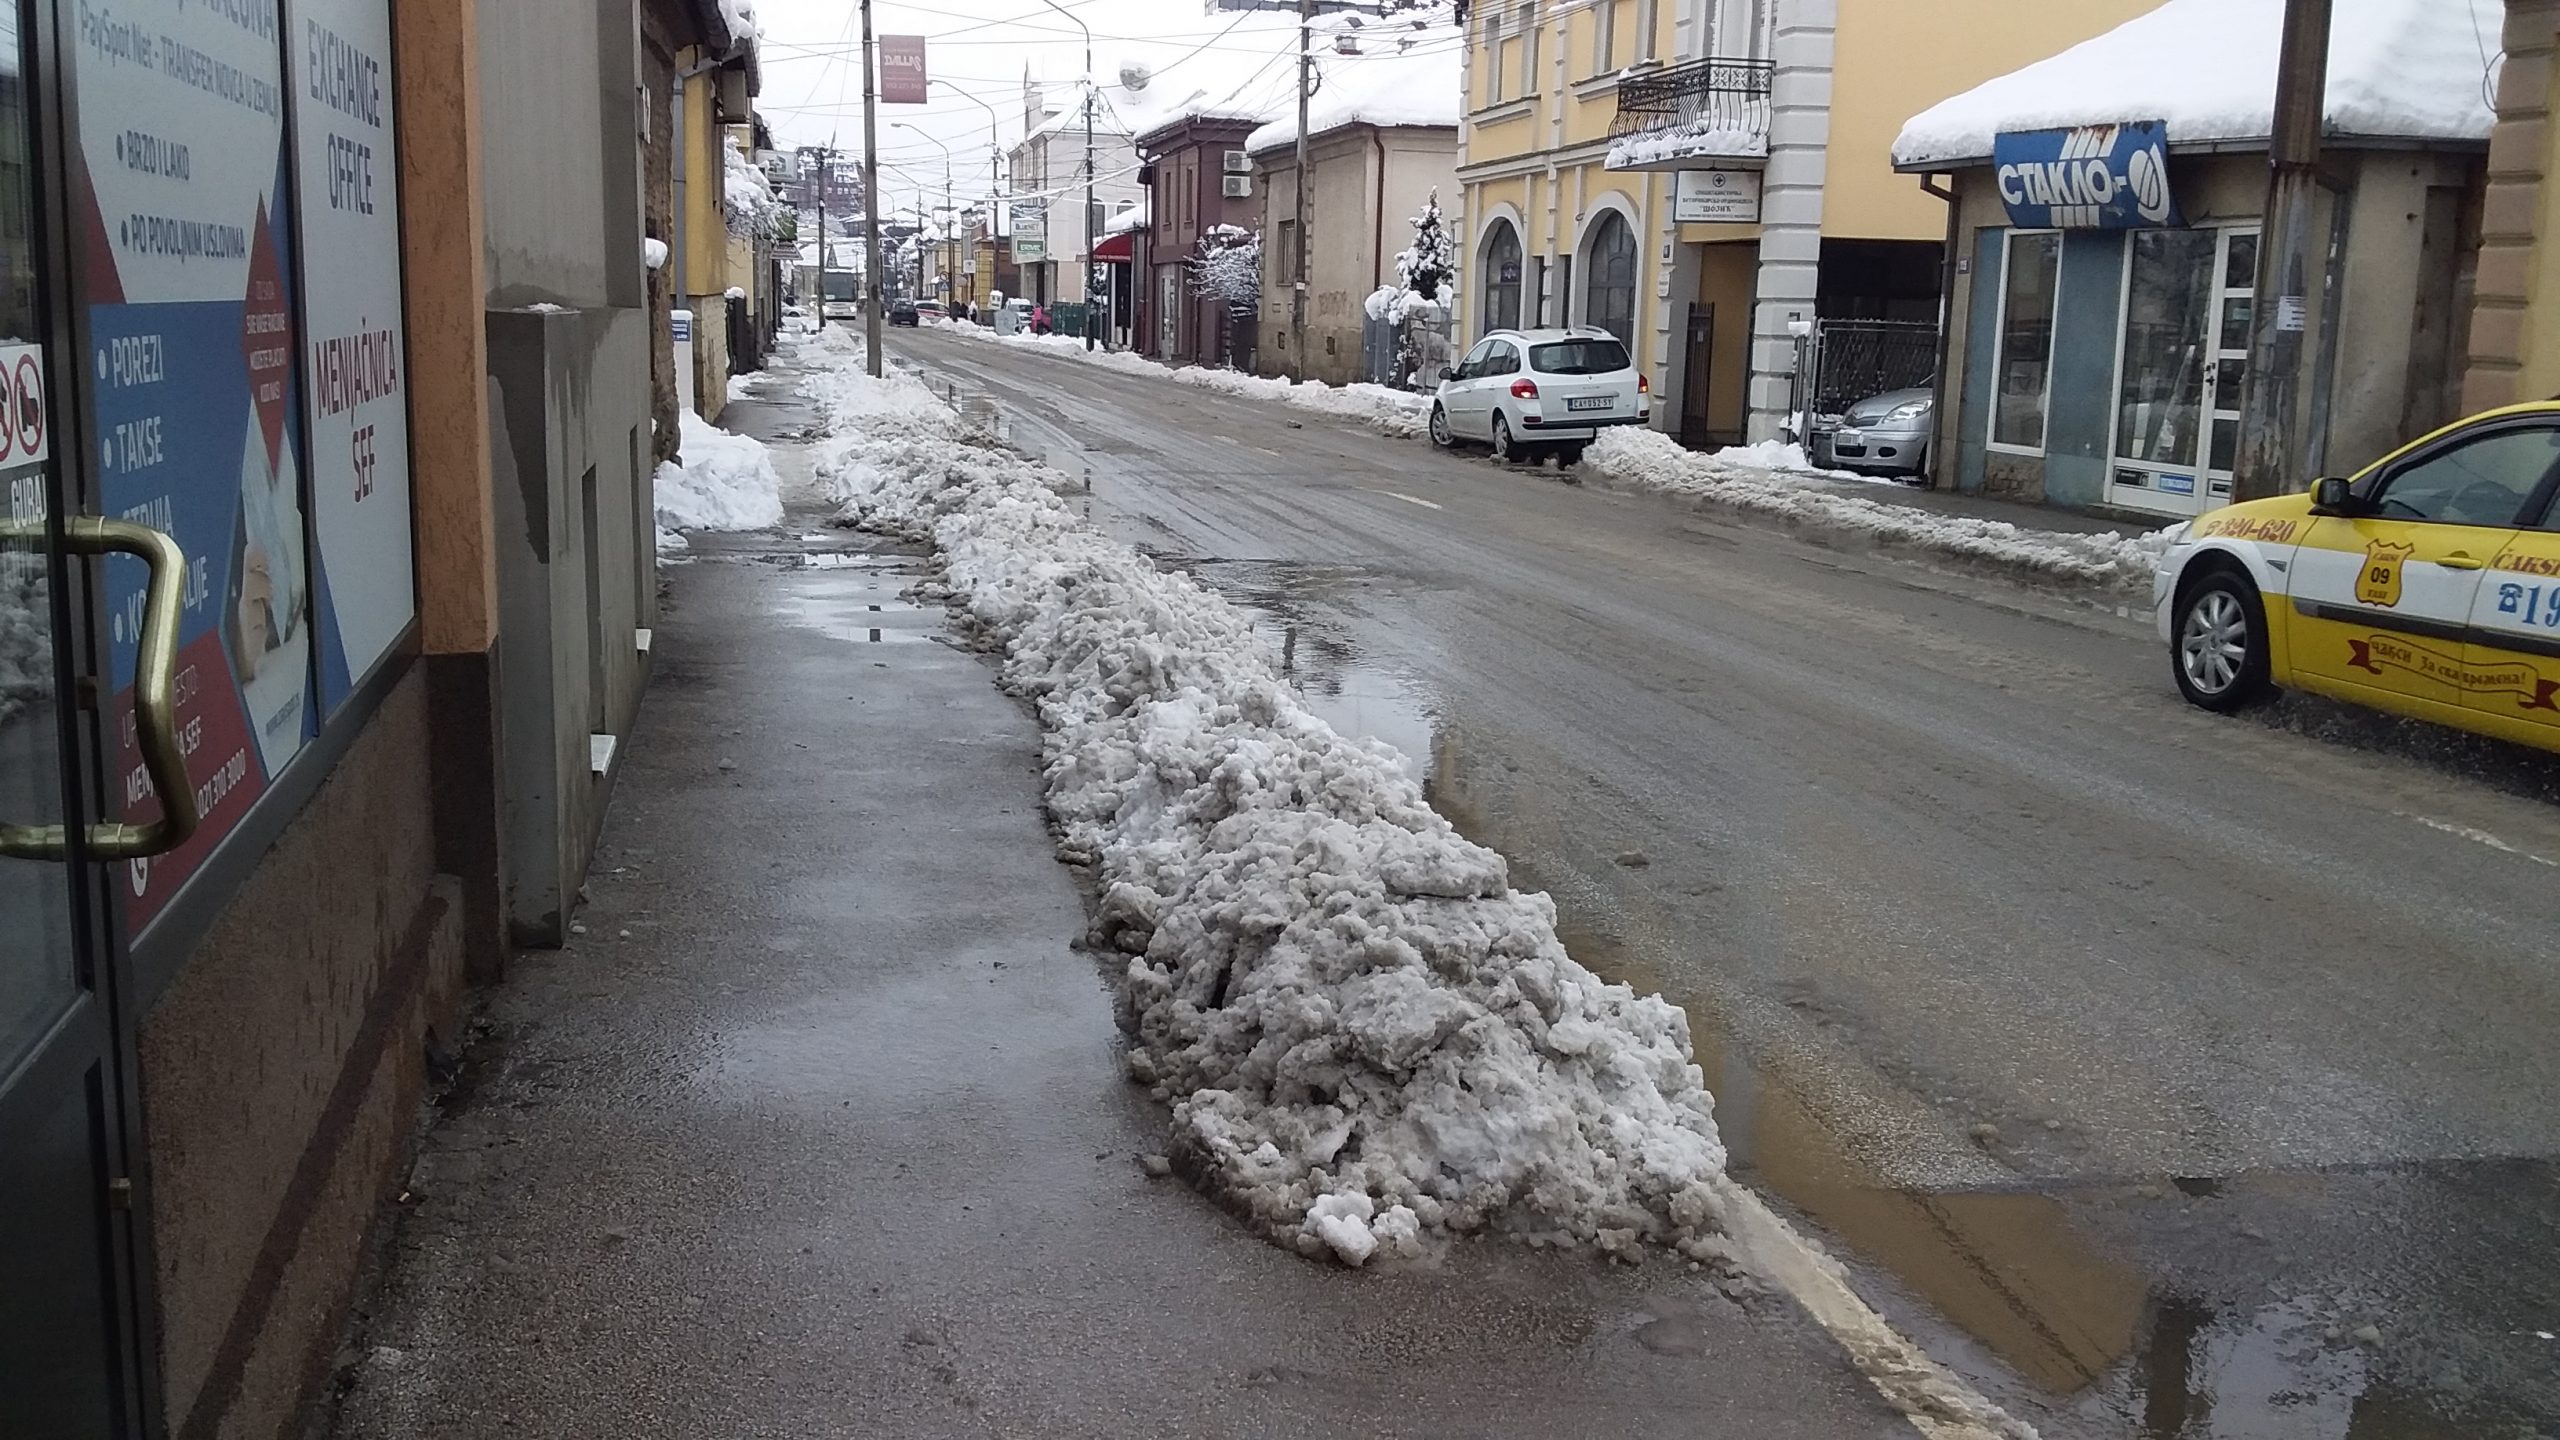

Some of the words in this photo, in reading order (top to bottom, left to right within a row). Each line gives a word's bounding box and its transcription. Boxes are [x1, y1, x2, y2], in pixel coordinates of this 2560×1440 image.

[307, 17, 381, 128] EXCHANGE
[127, 130, 156, 174] BRZO
[163, 140, 190, 181] LAKO
[327, 132, 373, 215] OFFICE
[131, 214, 147, 253] PO
[112, 335, 164, 388] POREZI
[315, 316, 397, 427] MENJAČNICA
[116, 416, 163, 474] TAKSE
[353, 424, 375, 503] SEF
[11, 473, 48, 530] GURAJ
[2219, 518, 2296, 542] 320-620
[2371, 567, 2390, 584] 09
[186, 715, 201, 755] SEF
[198, 779, 213, 820] 021
[212, 771, 227, 805] 310
[227, 748, 246, 791] 3000
